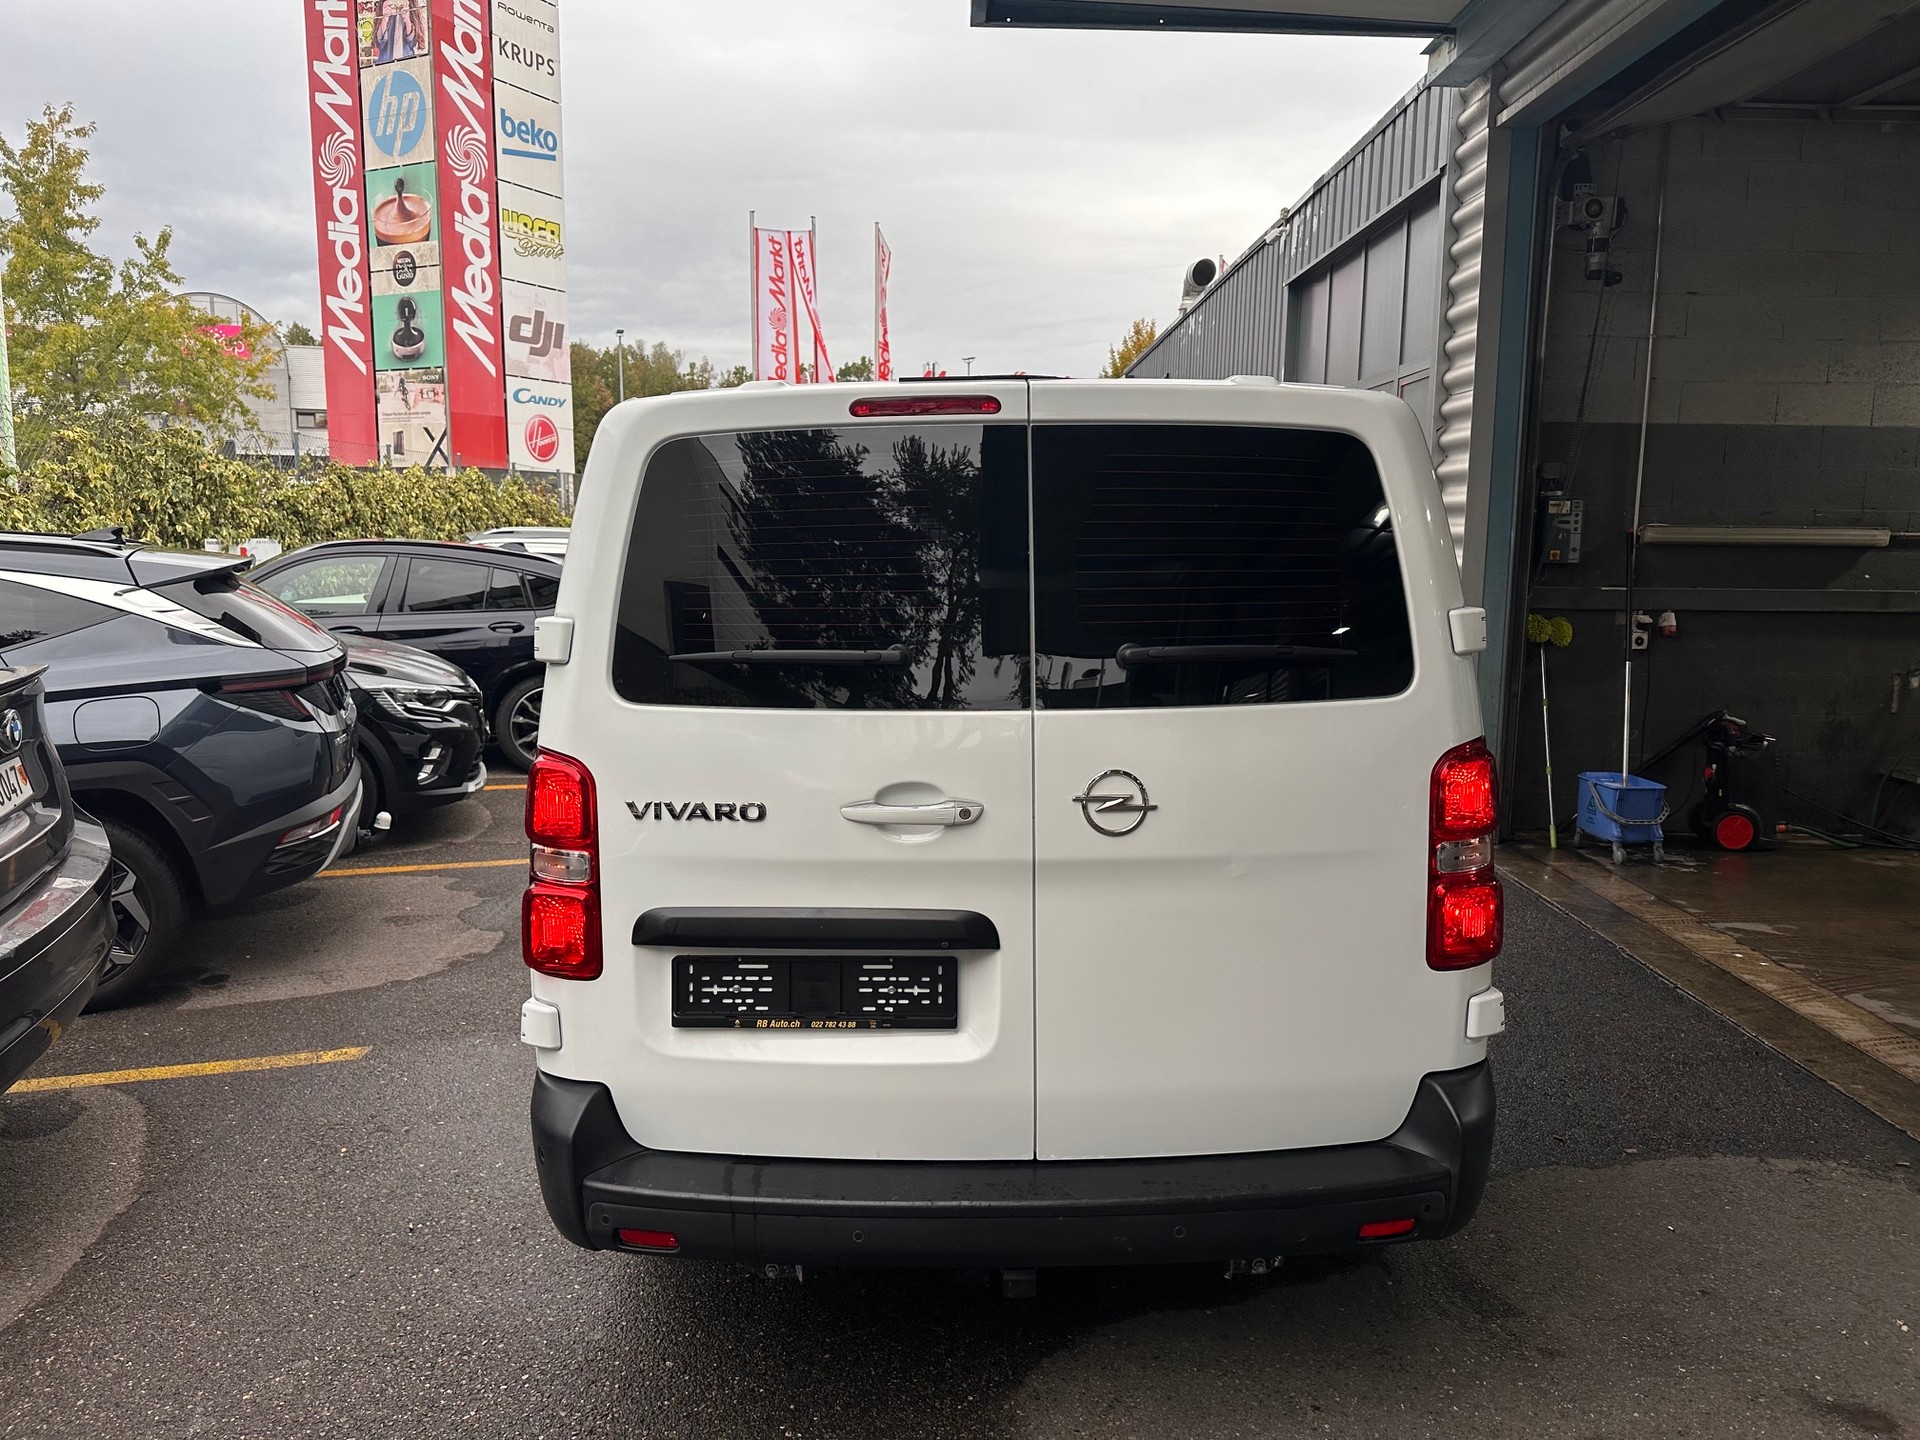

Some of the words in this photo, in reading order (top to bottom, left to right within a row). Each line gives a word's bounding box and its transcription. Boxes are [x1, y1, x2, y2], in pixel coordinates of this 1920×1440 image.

[440, 0, 486, 145] Mar
[498, 37, 555, 77] KRUPS
[500, 107, 558, 153] beko
[624, 800, 768, 823] VIVARO
[756, 1019, 768, 1028] RB
[769, 1019, 801, 1028] Auto.ch
